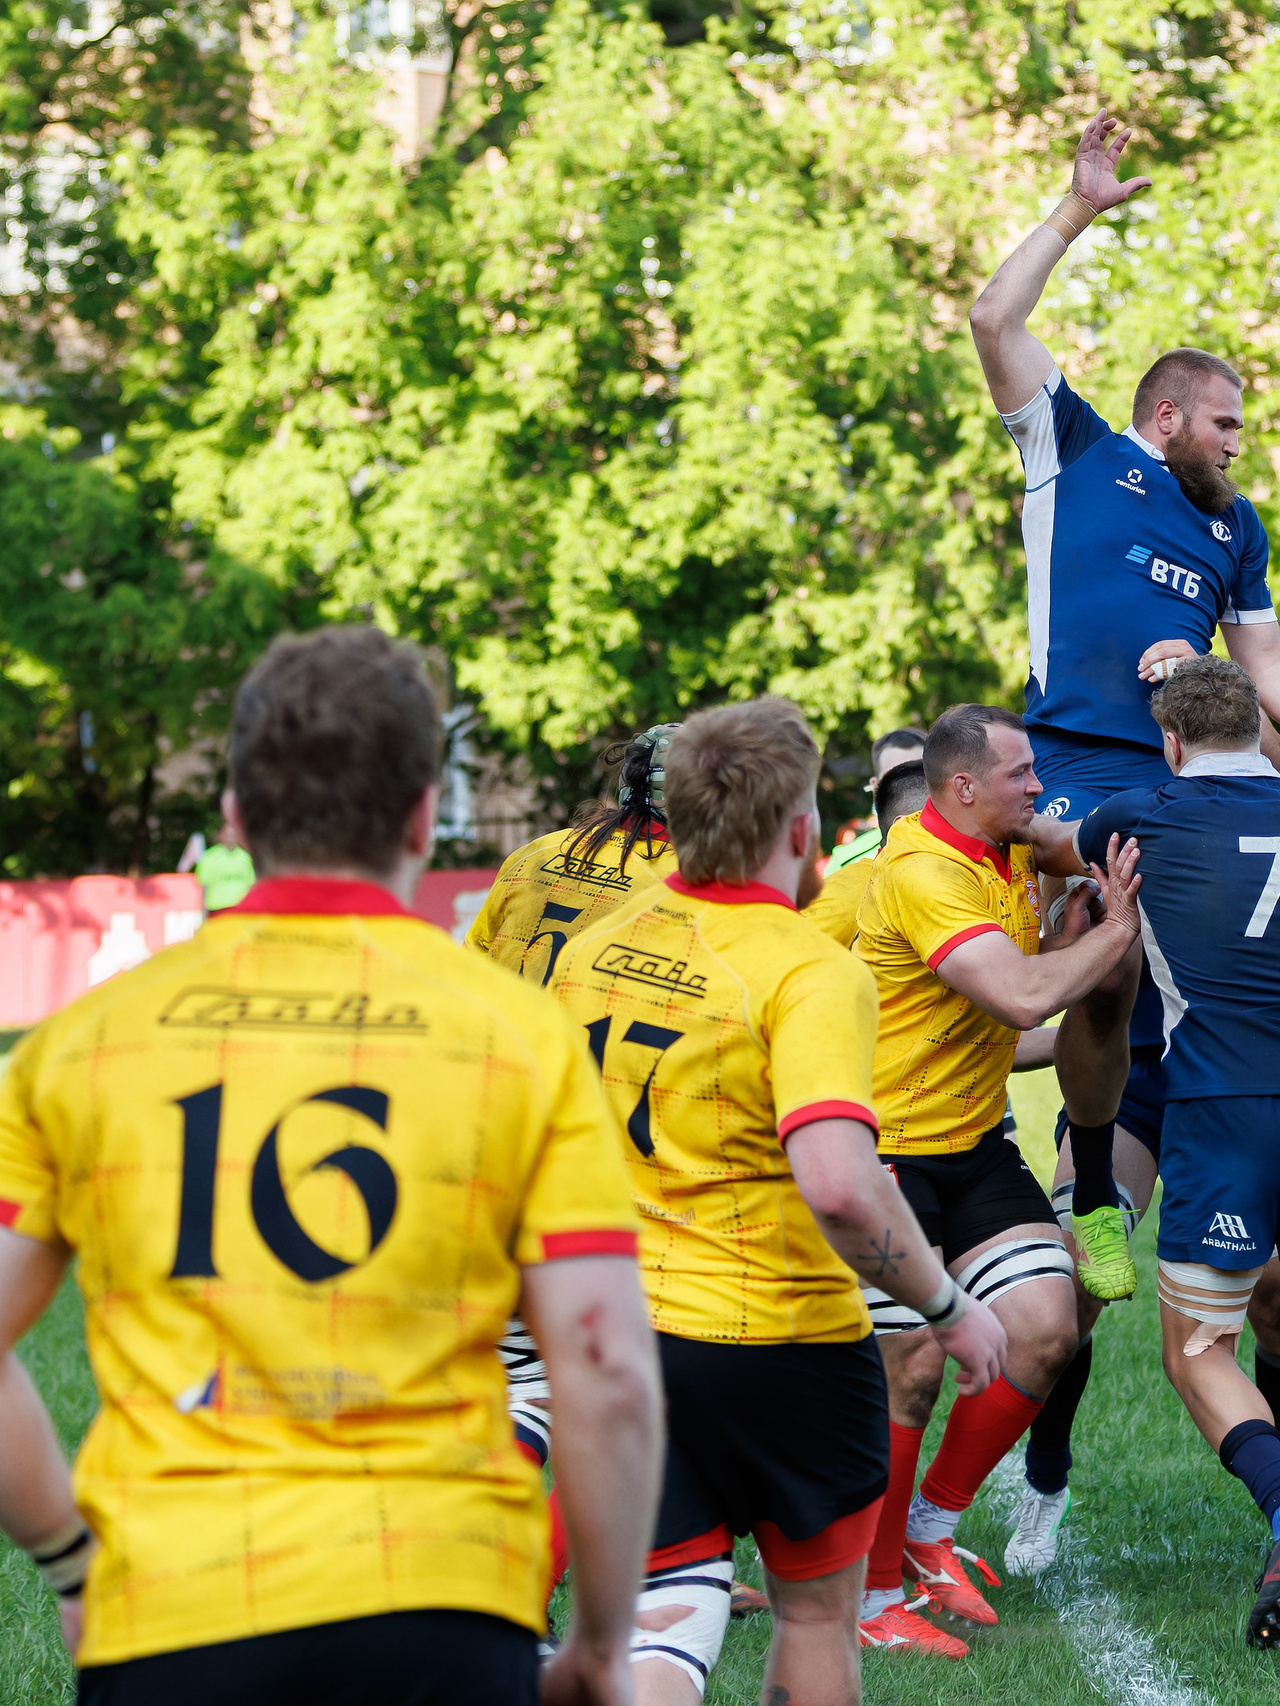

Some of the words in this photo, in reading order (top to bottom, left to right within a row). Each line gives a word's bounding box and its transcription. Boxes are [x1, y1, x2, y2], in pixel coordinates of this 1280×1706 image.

[1115, 478, 1146, 496] centurion
[1150, 557, 1202, 600] ВТБ
[518, 901, 585, 990] 5
[583, 1014, 686, 1159] 17
[164, 1083, 398, 1284] 16
[1201, 1236, 1257, 1252] ARBATHALL
